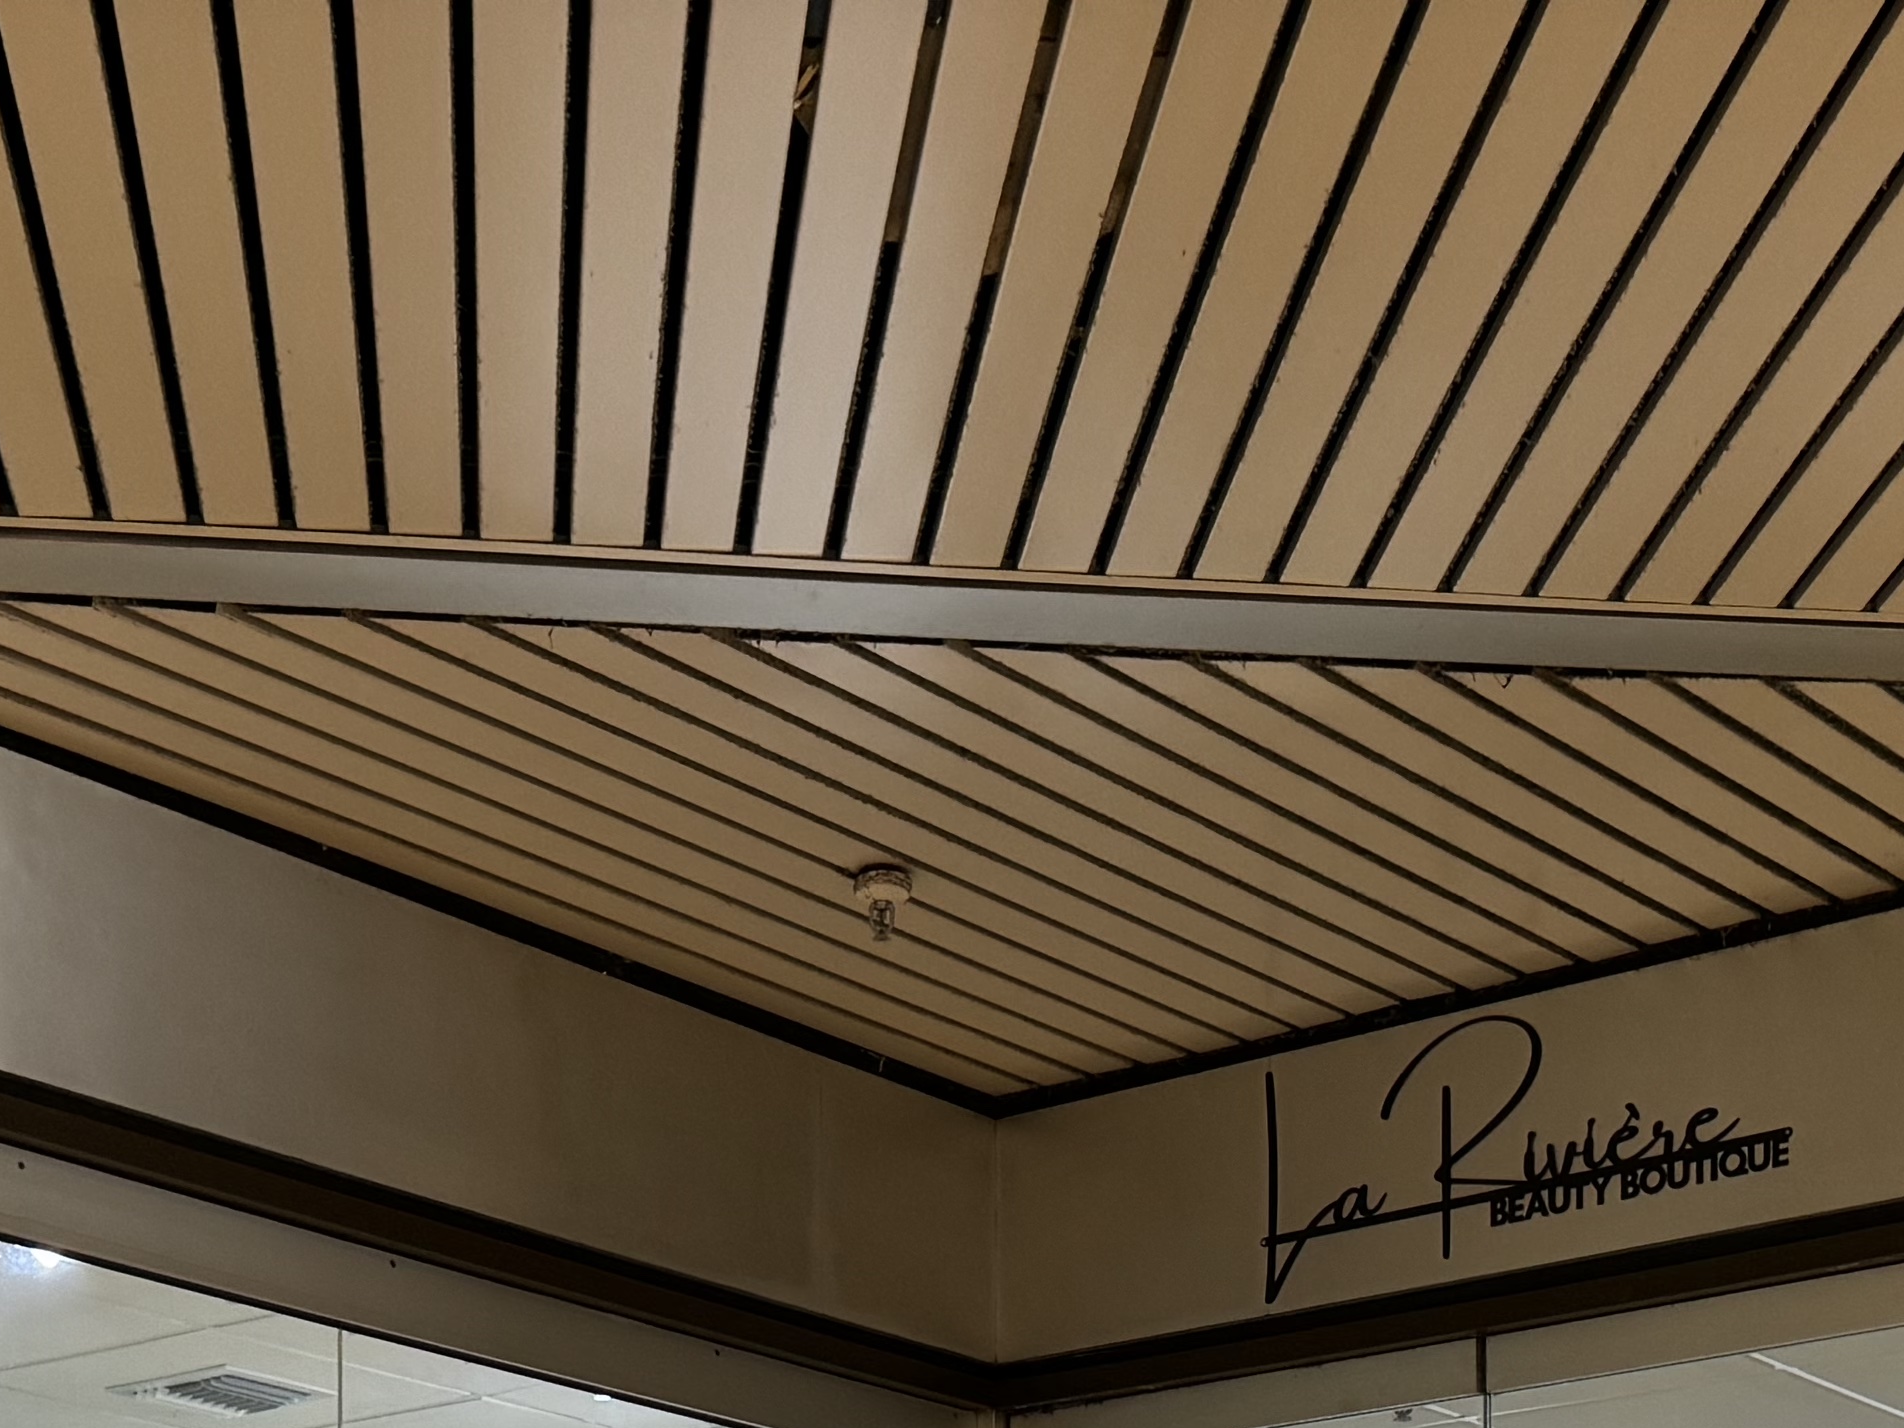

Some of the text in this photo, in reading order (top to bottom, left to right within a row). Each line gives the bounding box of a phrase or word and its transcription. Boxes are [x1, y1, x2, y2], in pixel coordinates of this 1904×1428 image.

[1264, 1014, 1742, 1304] La Rivière
[1489, 1135, 1790, 1228] BEAUTY BOUTIQUE
